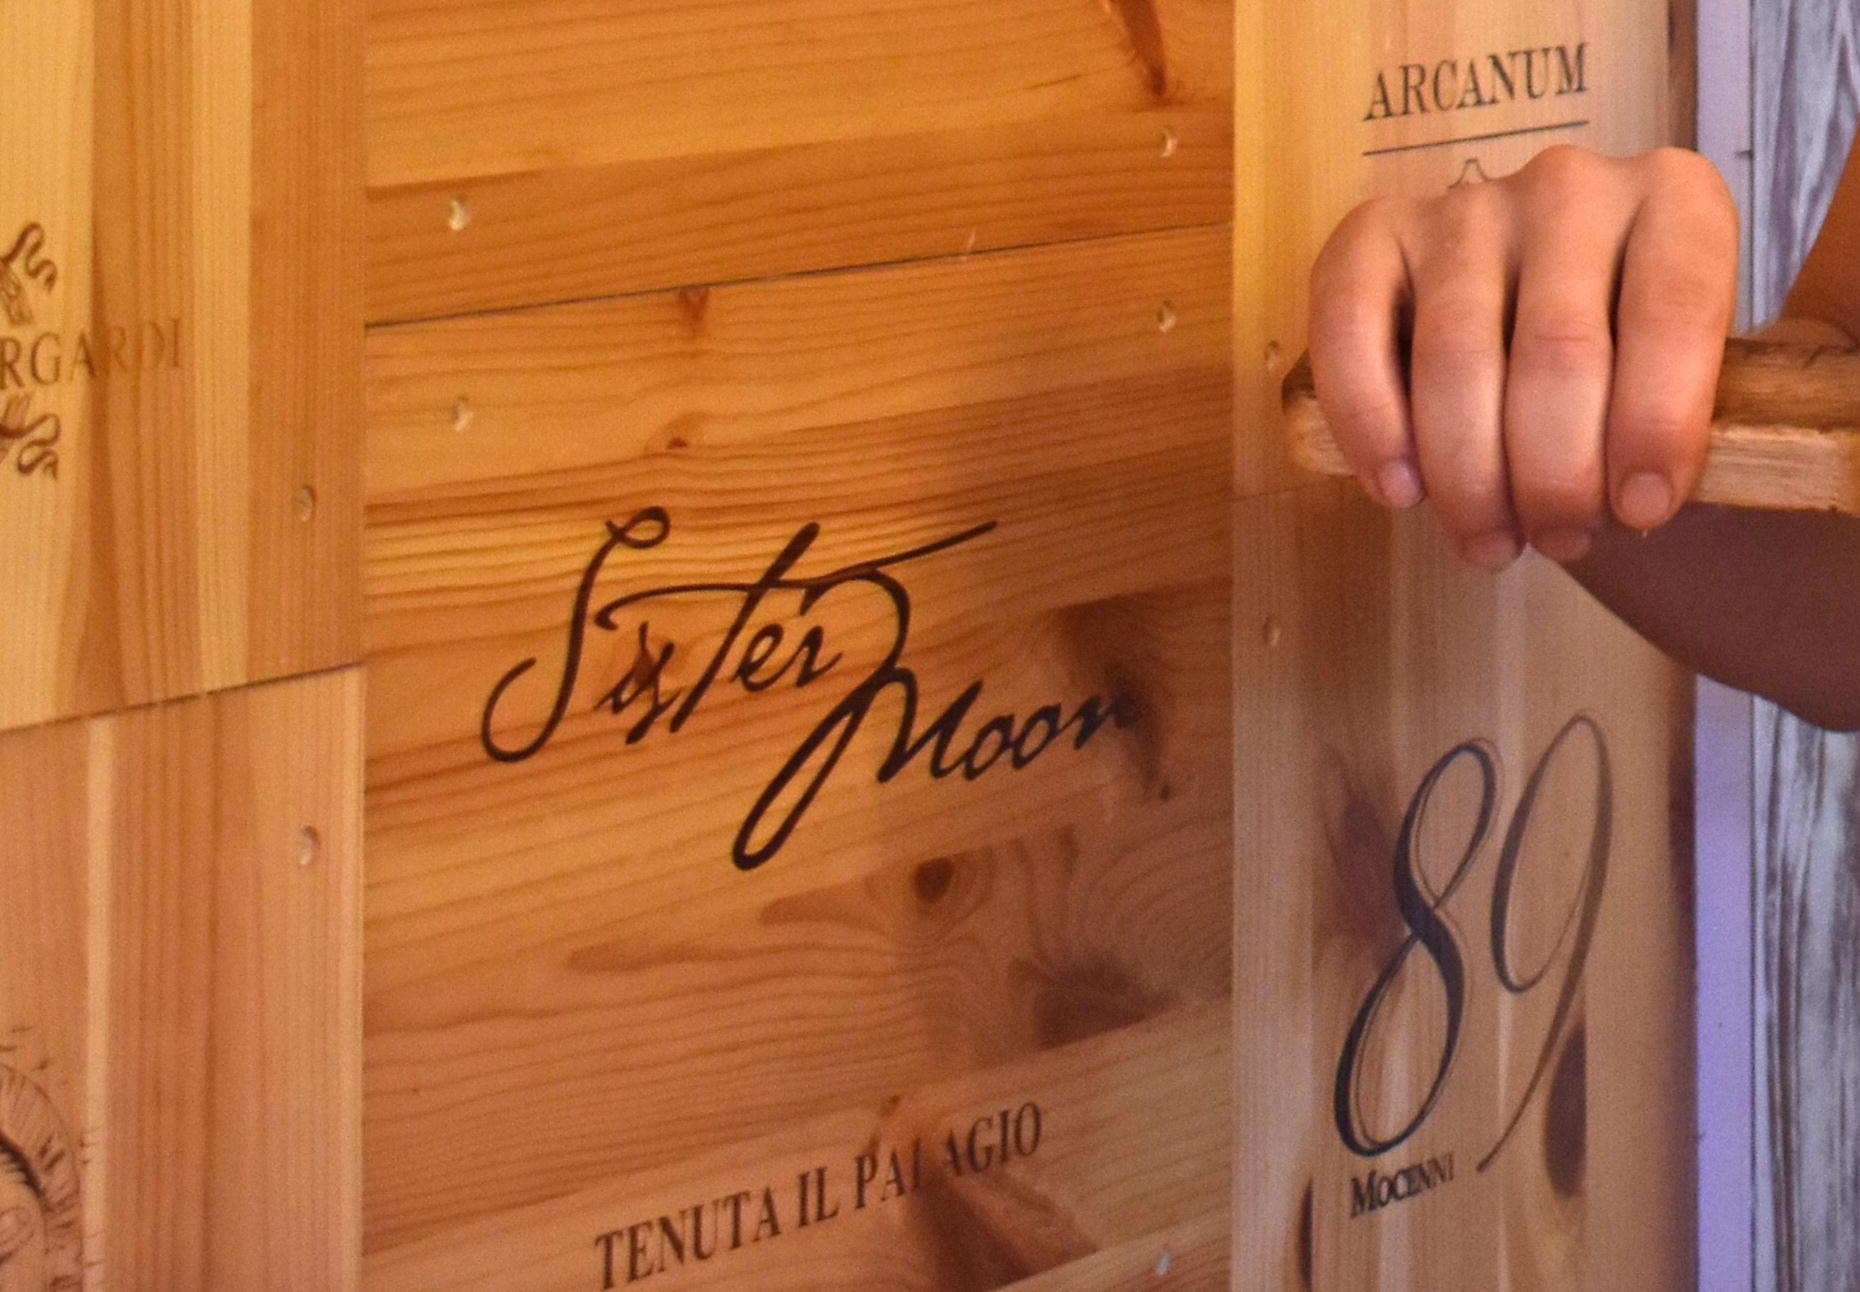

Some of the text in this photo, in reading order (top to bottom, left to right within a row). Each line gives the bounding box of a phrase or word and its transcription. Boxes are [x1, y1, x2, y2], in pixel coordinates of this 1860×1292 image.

[1363, 42, 1589, 122] ARCANUM
[481, 506, 1141, 870] Sister Moon
[1334, 714, 1613, 1173] 89
[594, 1101, 1043, 1290] TENUTA IL PALAGIO
